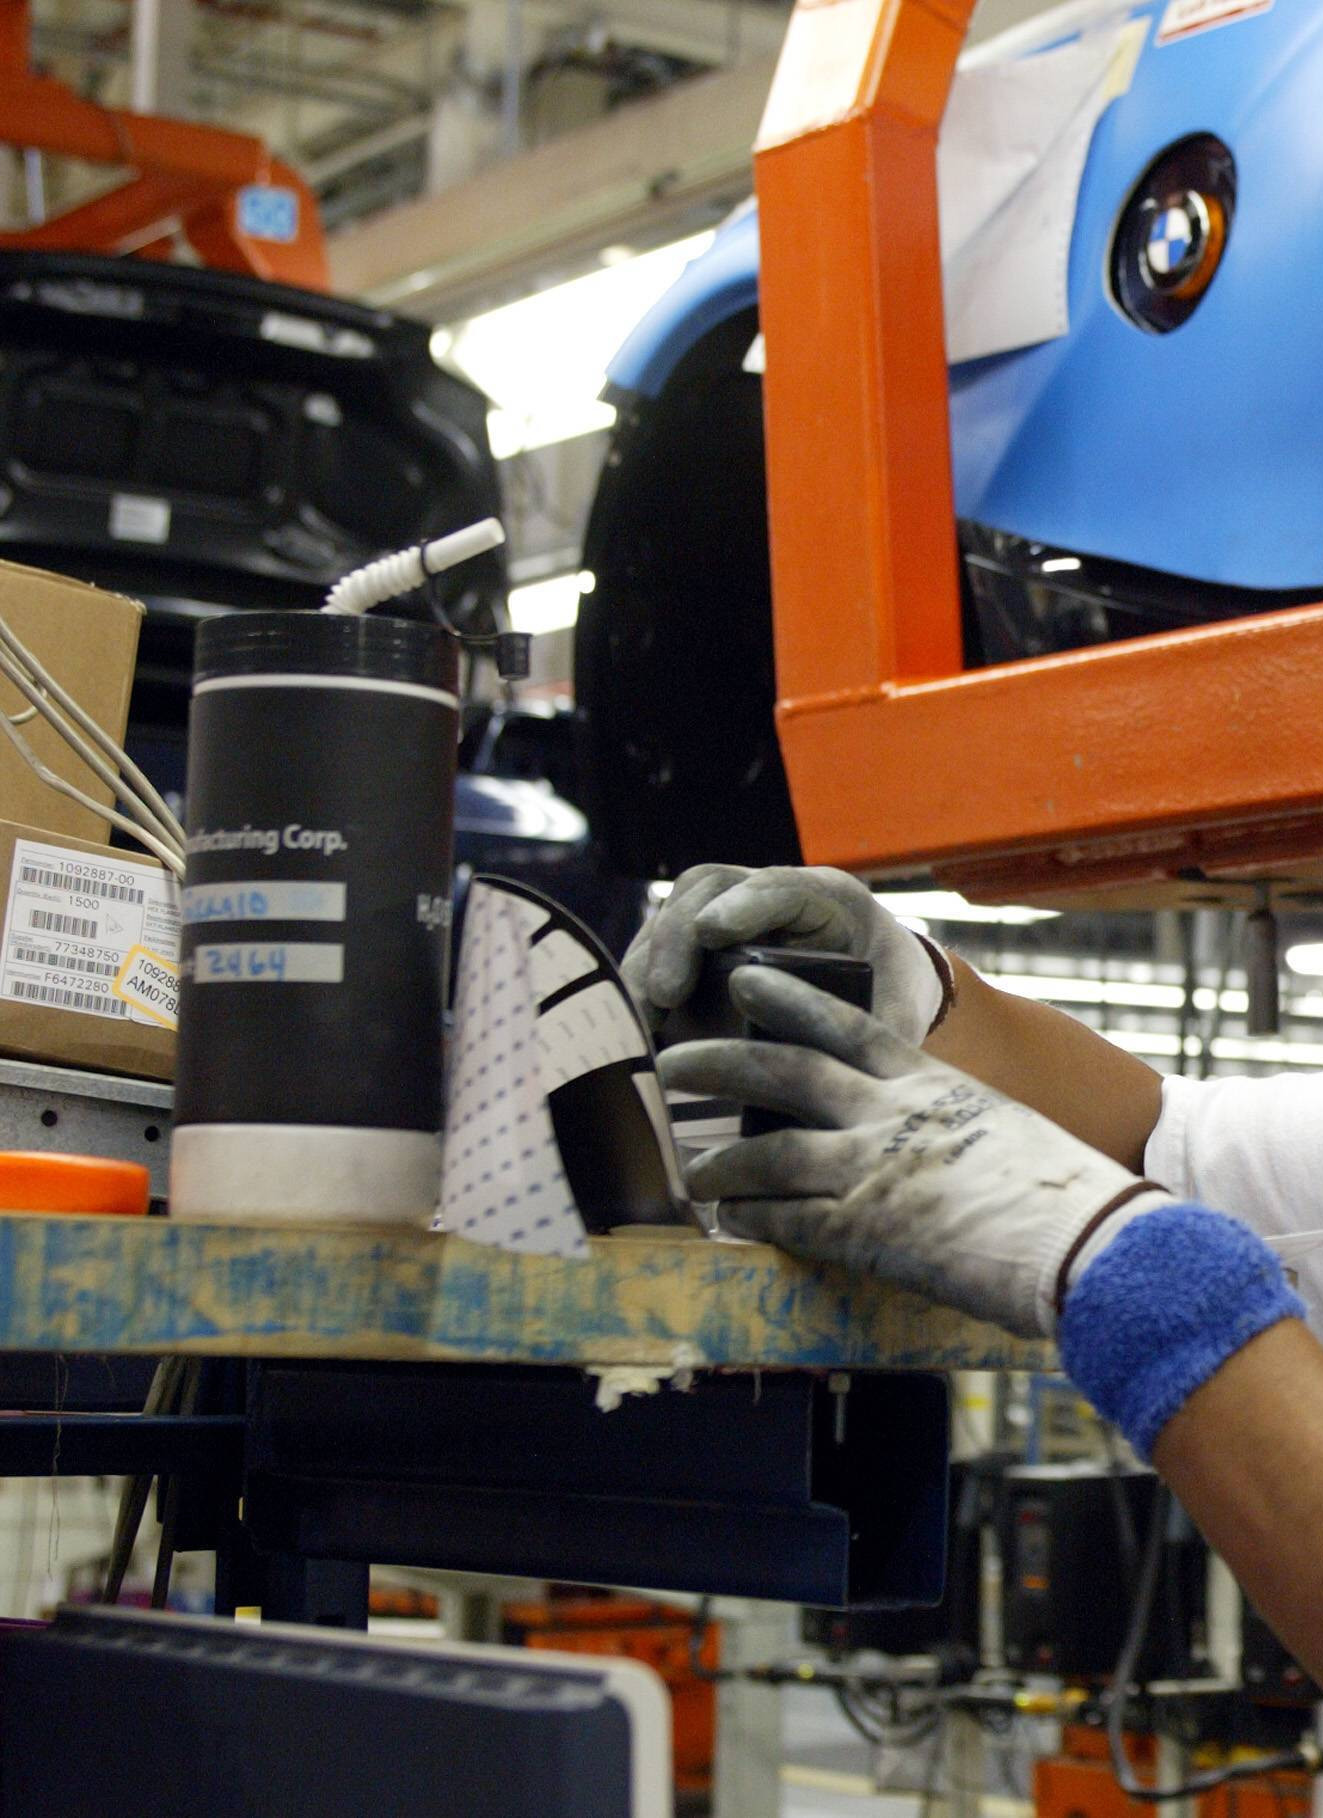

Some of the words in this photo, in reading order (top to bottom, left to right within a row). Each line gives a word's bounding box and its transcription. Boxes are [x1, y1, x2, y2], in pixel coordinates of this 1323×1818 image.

[283, 823, 348, 856] Corp.
[59, 862, 135, 886] 1092887-00
[68, 895, 100, 911] 1500
[54, 941, 120, 964] 77348750
[44, 972, 110, 994] F6472280
